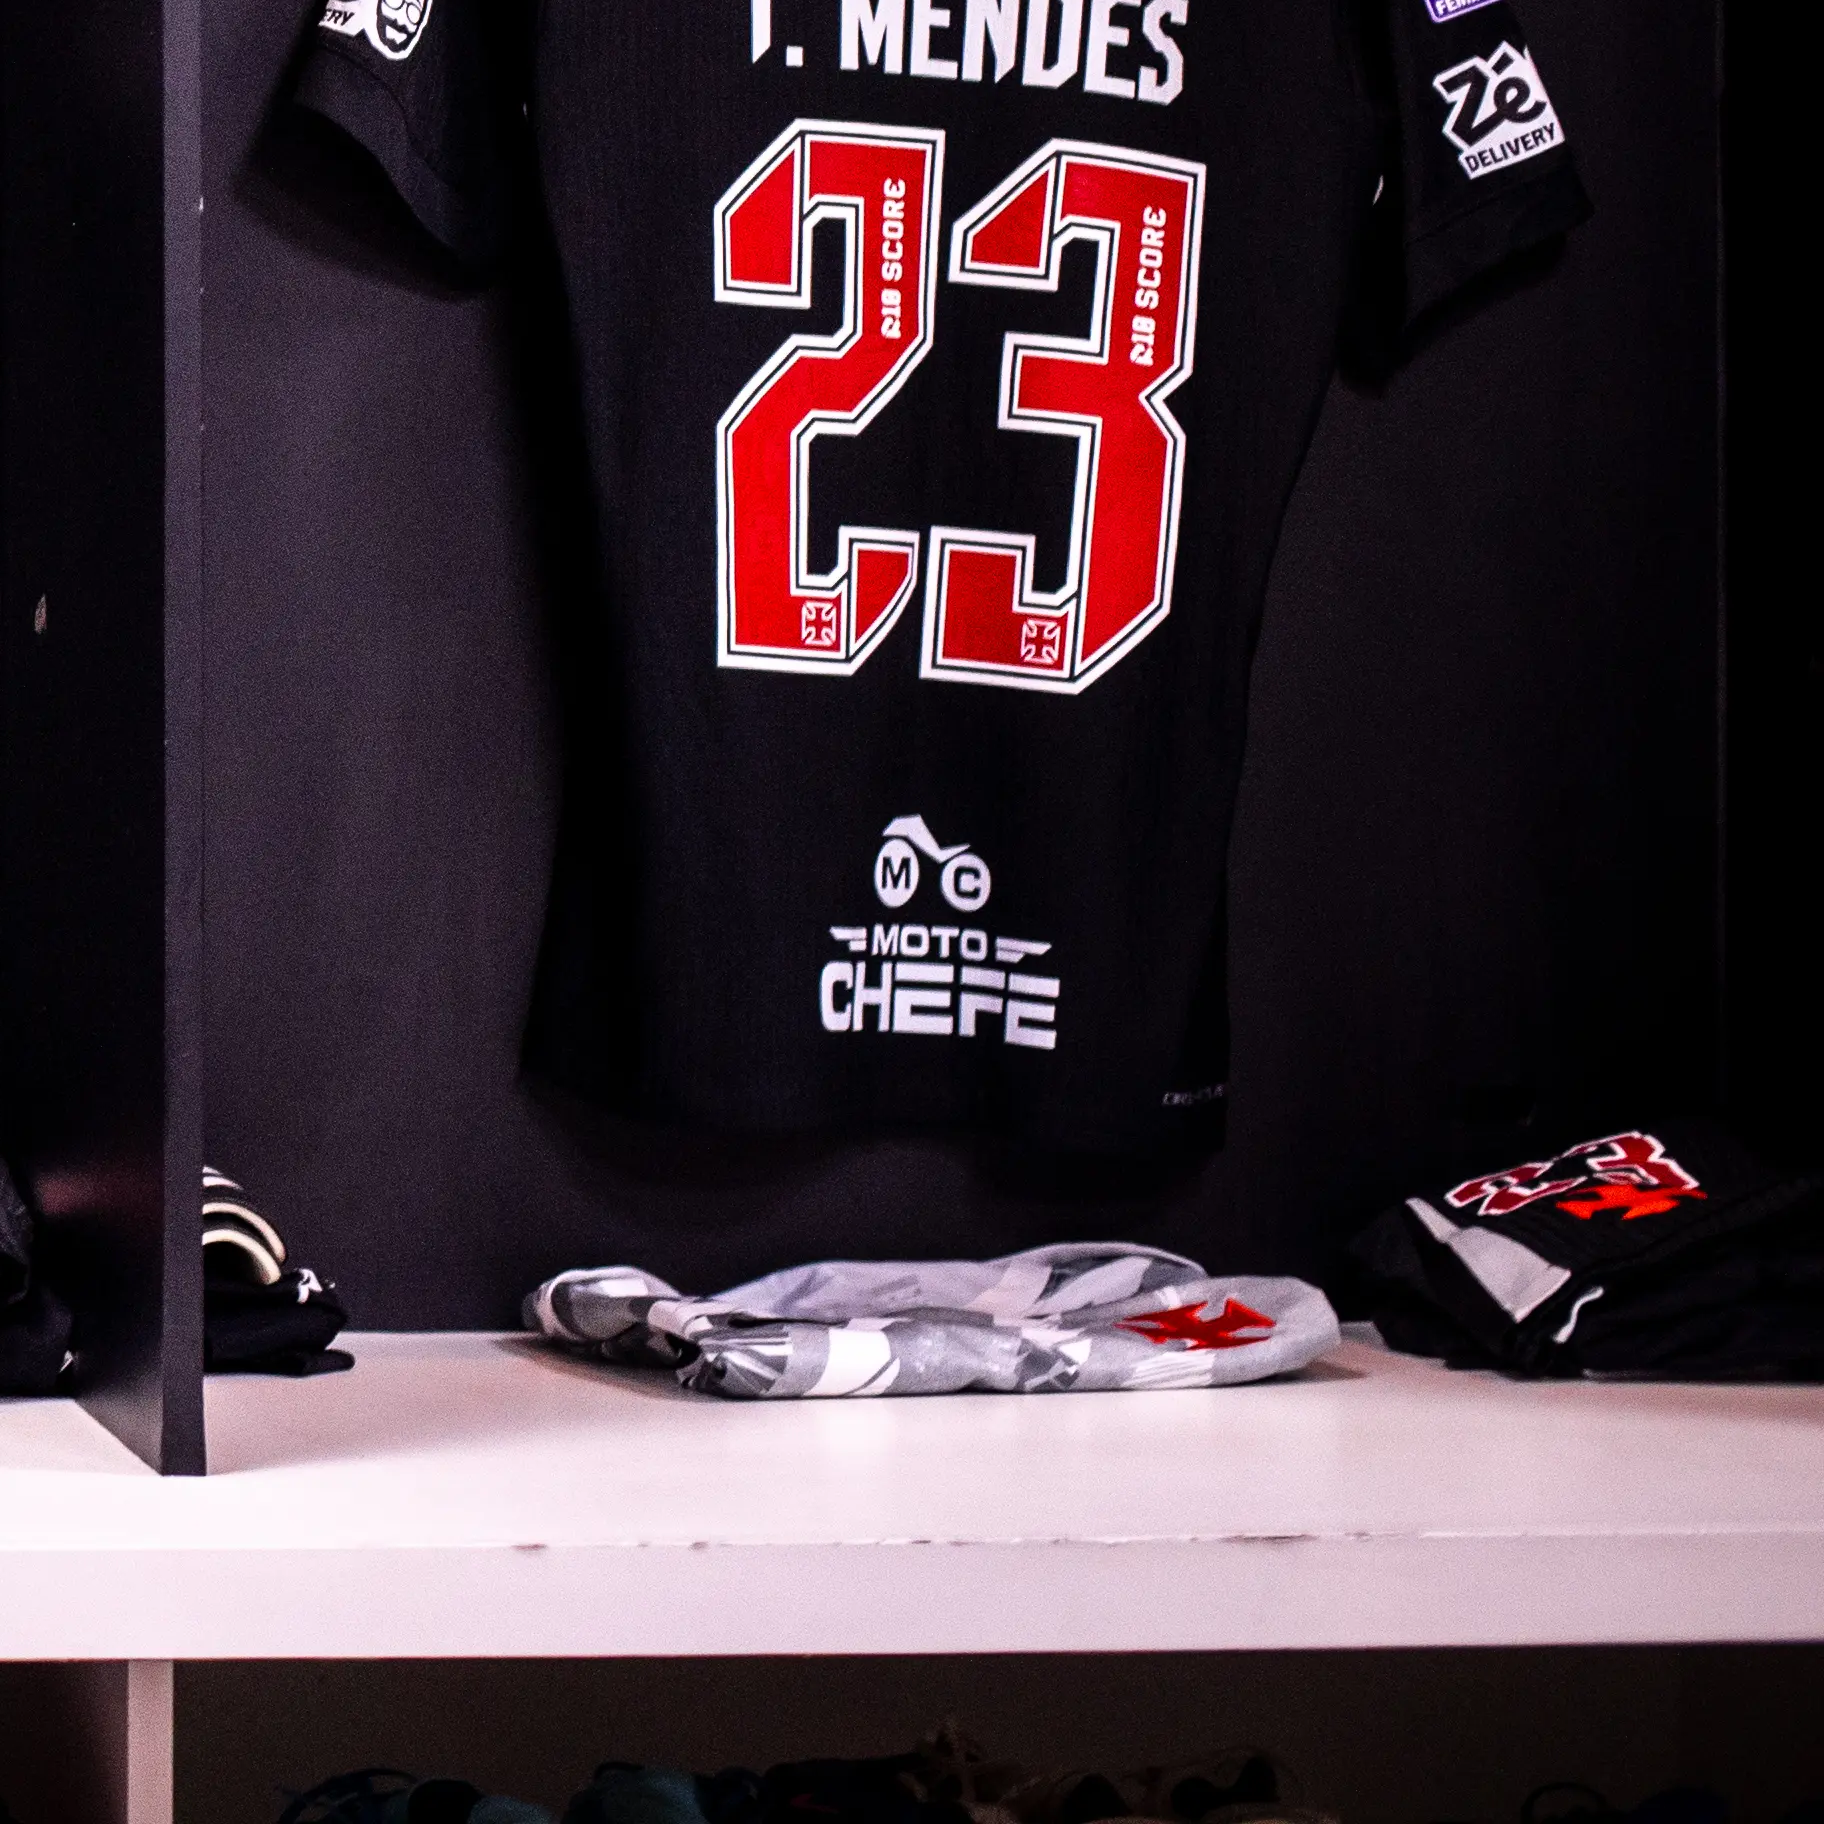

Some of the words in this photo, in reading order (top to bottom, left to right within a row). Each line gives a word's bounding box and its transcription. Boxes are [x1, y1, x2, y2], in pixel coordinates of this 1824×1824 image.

[1440, 51, 1548, 148] Zé
[1464, 121, 1556, 173] DELIVERY
[881, 177, 906, 282] SCORE
[1134, 205, 1167, 310] SCORE
[713, 117, 1207, 696] 23
[871, 923, 988, 961] MOTO
[820, 960, 1061, 1050] CHEFE
